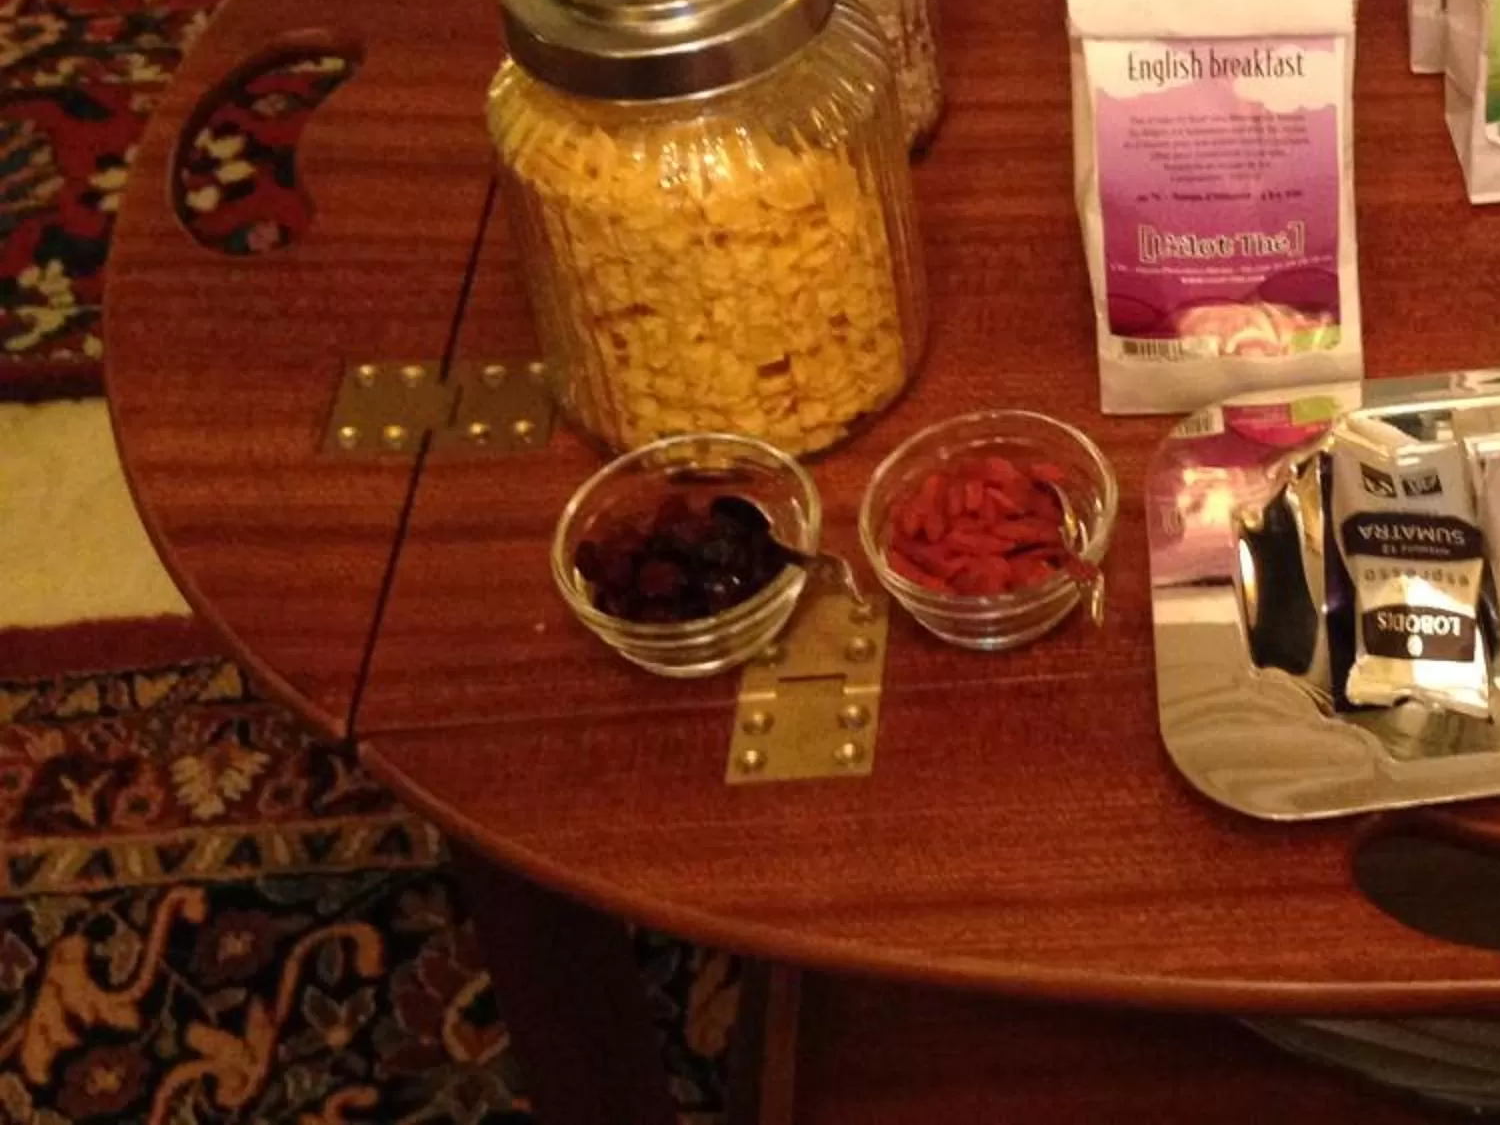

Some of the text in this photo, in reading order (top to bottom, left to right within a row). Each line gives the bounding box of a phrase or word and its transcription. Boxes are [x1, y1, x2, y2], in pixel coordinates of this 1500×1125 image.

[1128, 46, 1305, 87] English breakfast
[1357, 524, 1465, 546] SUMATRA
[1363, 568, 1469, 588] espresso
[1377, 611, 1461, 635] LOBODIS
